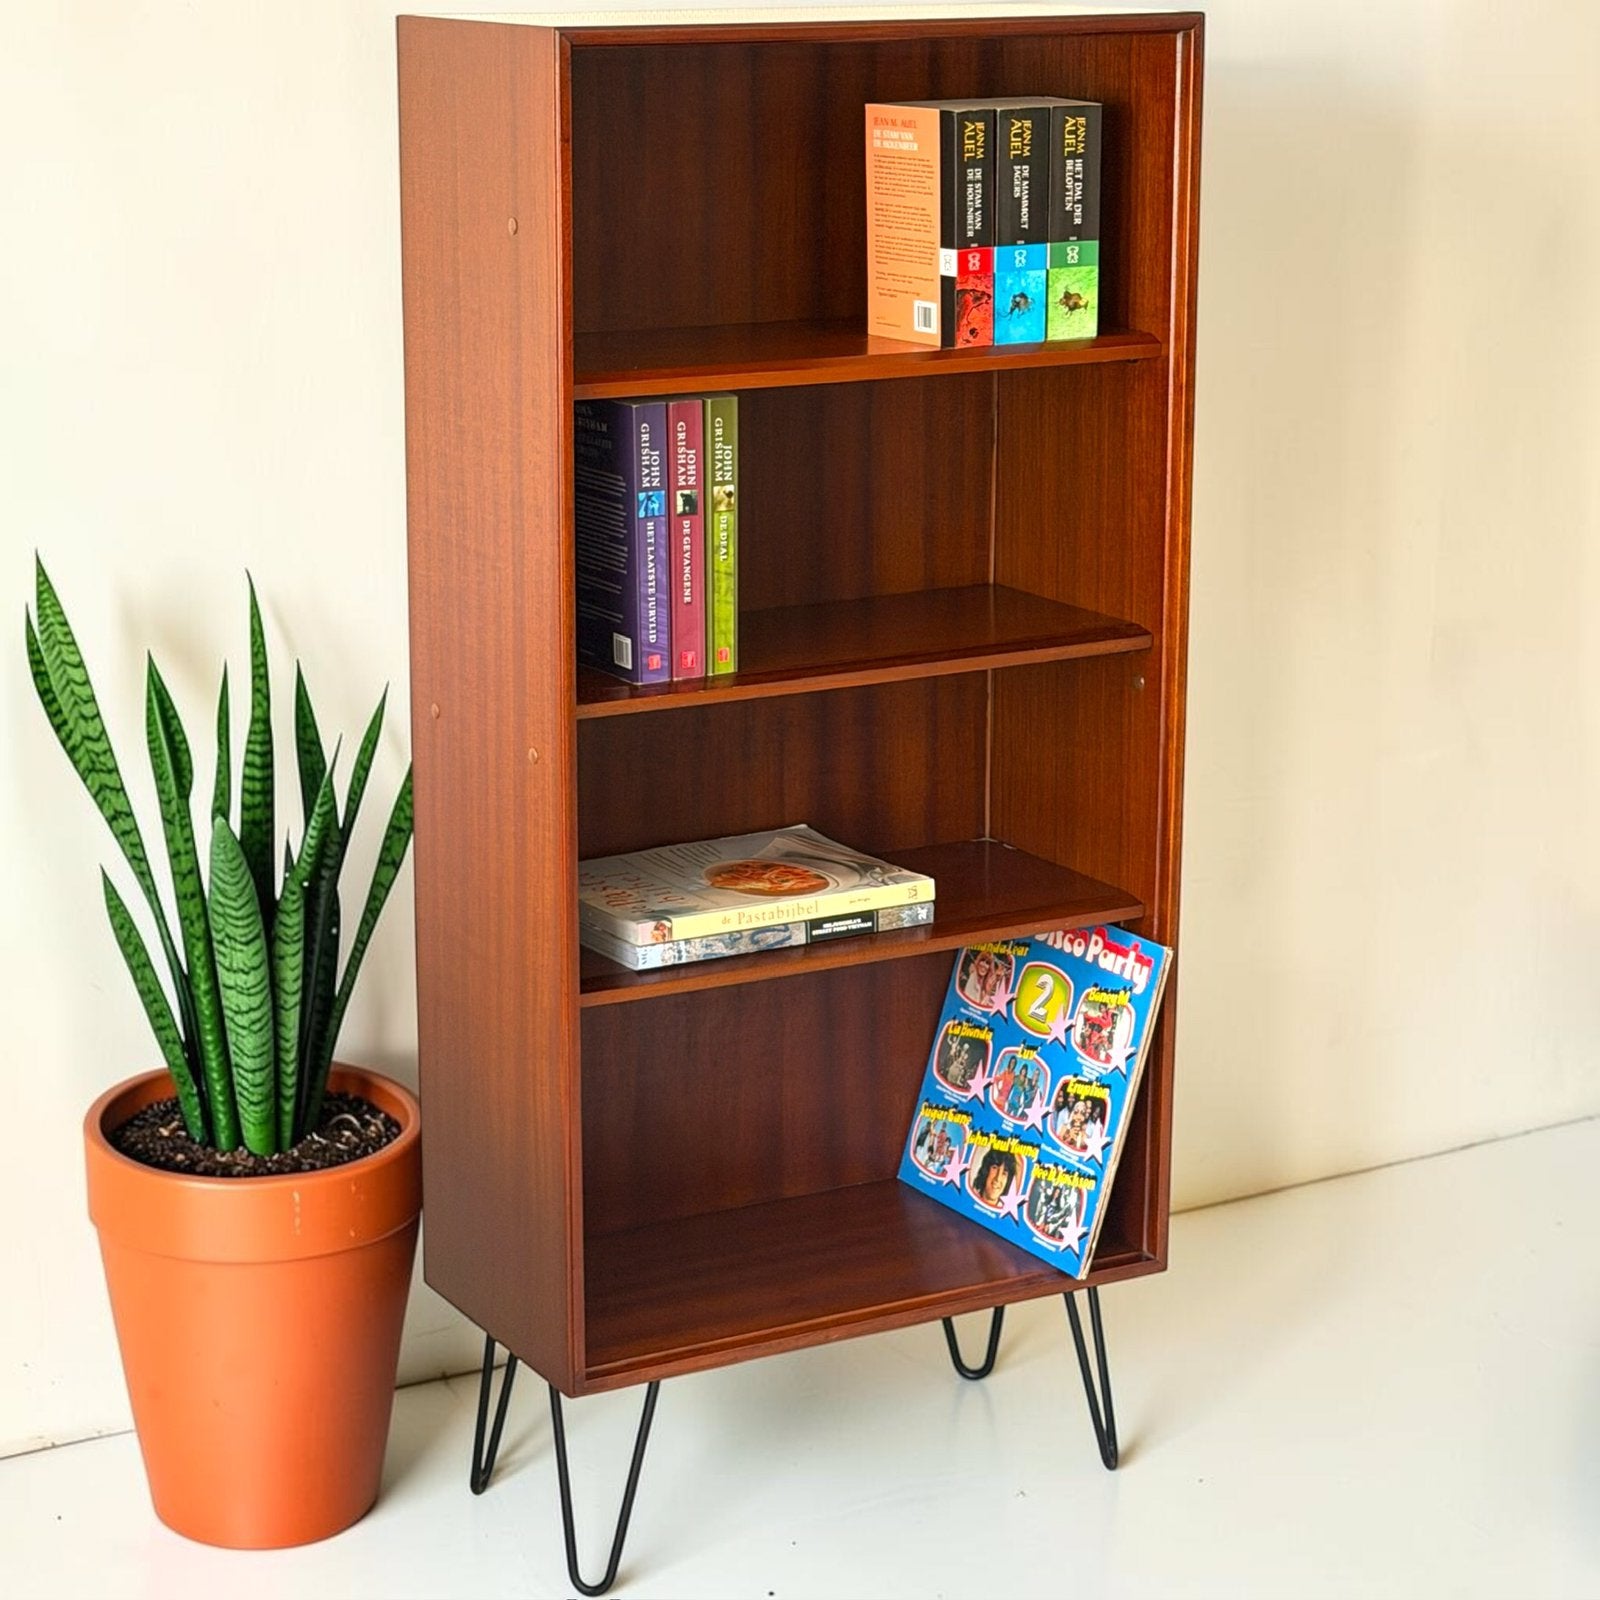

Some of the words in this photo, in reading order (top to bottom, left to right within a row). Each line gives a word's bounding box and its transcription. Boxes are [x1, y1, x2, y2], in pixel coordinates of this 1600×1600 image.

[964, 121, 975, 162] AUEL
[975, 122, 984, 146] JEAN
[1010, 119, 1022, 160] AUEL
[1022, 120, 1032, 144] JEAN
[1064, 116, 1076, 156] AUEL
[1076, 117, 1086, 140] JEAN
[976, 148, 984, 159] M
[1023, 146, 1031, 157] M
[1076, 143, 1085, 154] M
[966, 168, 974, 181] DE
[974, 168, 982, 180] DE
[1013, 166, 1021, 198] JAGERS
[1022, 166, 1030, 178] DE
[1065, 160, 1074, 212] BELOFTEN
[974, 183, 982, 208] STAM
[1020, 181, 1030, 230] MAMMOET
[1074, 182, 1082, 202] DAL
[966, 184, 974, 238] HOLENBEER
[974, 210, 982, 230] VAN
[1074, 204, 1082, 225] DER
[641, 423, 650, 488] GRISHAM
[677, 422, 686, 486] GRISHAM
[714, 417, 723, 482] GRISHAM
[722, 445, 732, 481] JOHN
[650, 451, 660, 487] JOHN
[685, 450, 696, 486] JOHN
[646, 522, 654, 544] HET
[682, 520, 691, 536] DE
[720, 515, 728, 531] DE
[720, 532, 728, 562] DEAL
[648, 546, 656, 596] LAATSTE
[683, 536, 692, 604] GEVANGENE
[648, 597, 656, 644] JURYLID
[722, 915, 732, 925] de
[737, 900, 820, 925] Pastabijbel
[1085, 933, 1150, 995] Party
[1028, 974, 1054, 1024] 2
[1088, 986, 1119, 1009] Boney
